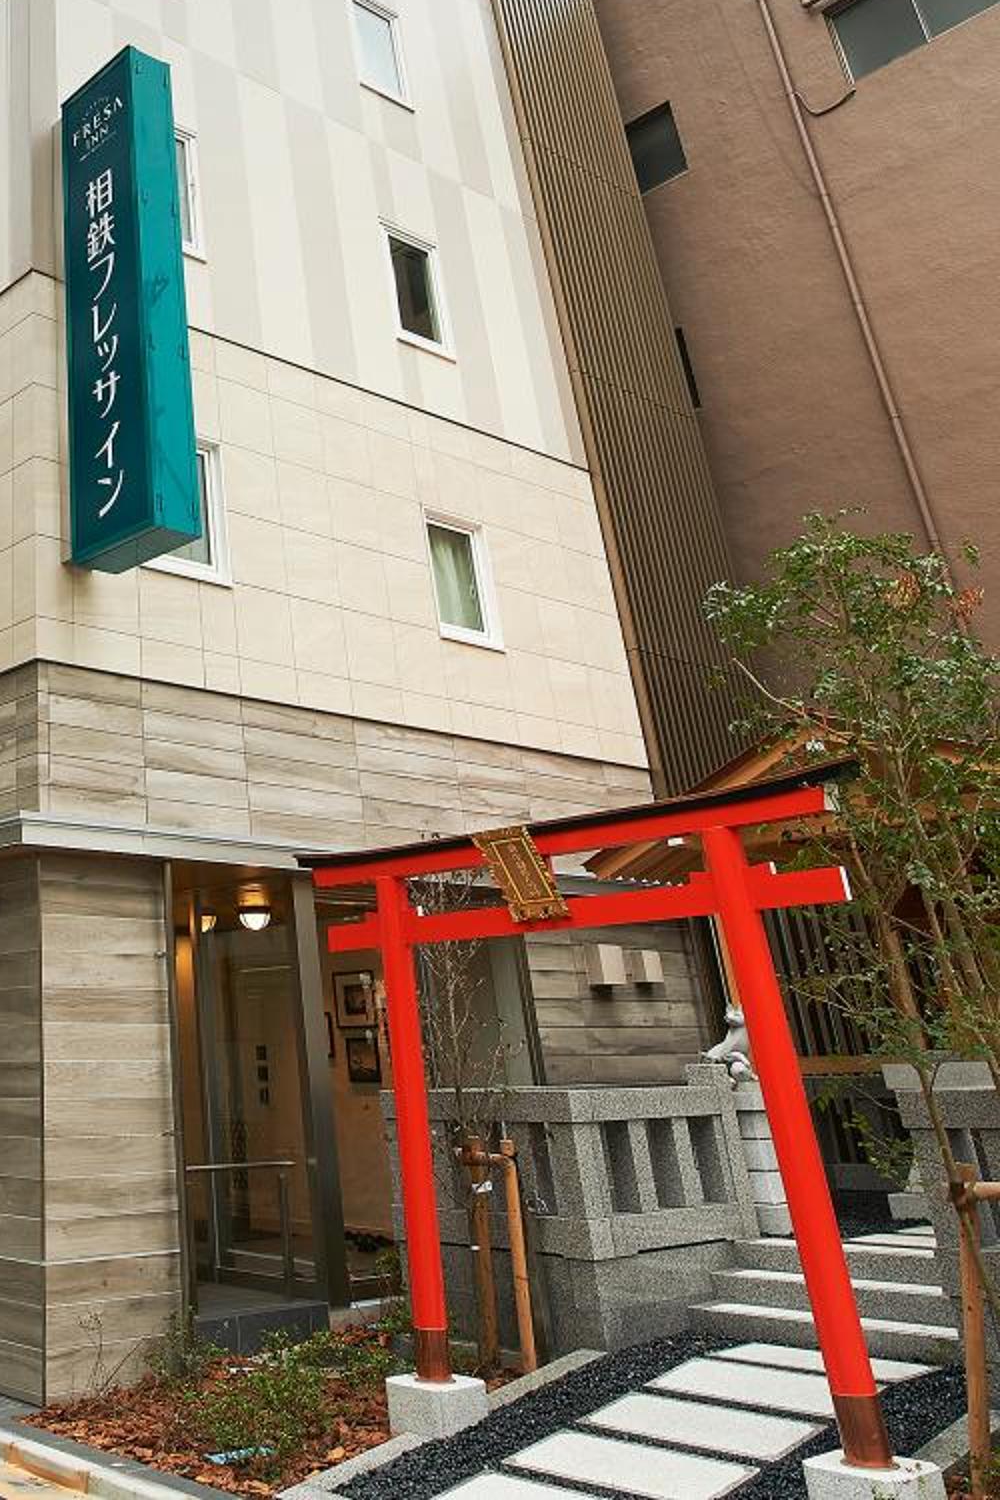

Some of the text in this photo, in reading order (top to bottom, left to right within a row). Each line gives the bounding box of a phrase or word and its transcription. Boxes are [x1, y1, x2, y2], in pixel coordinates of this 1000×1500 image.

[85, 124, 109, 150] INN
[85, 168, 125, 519] 相鉄フレッサイン
